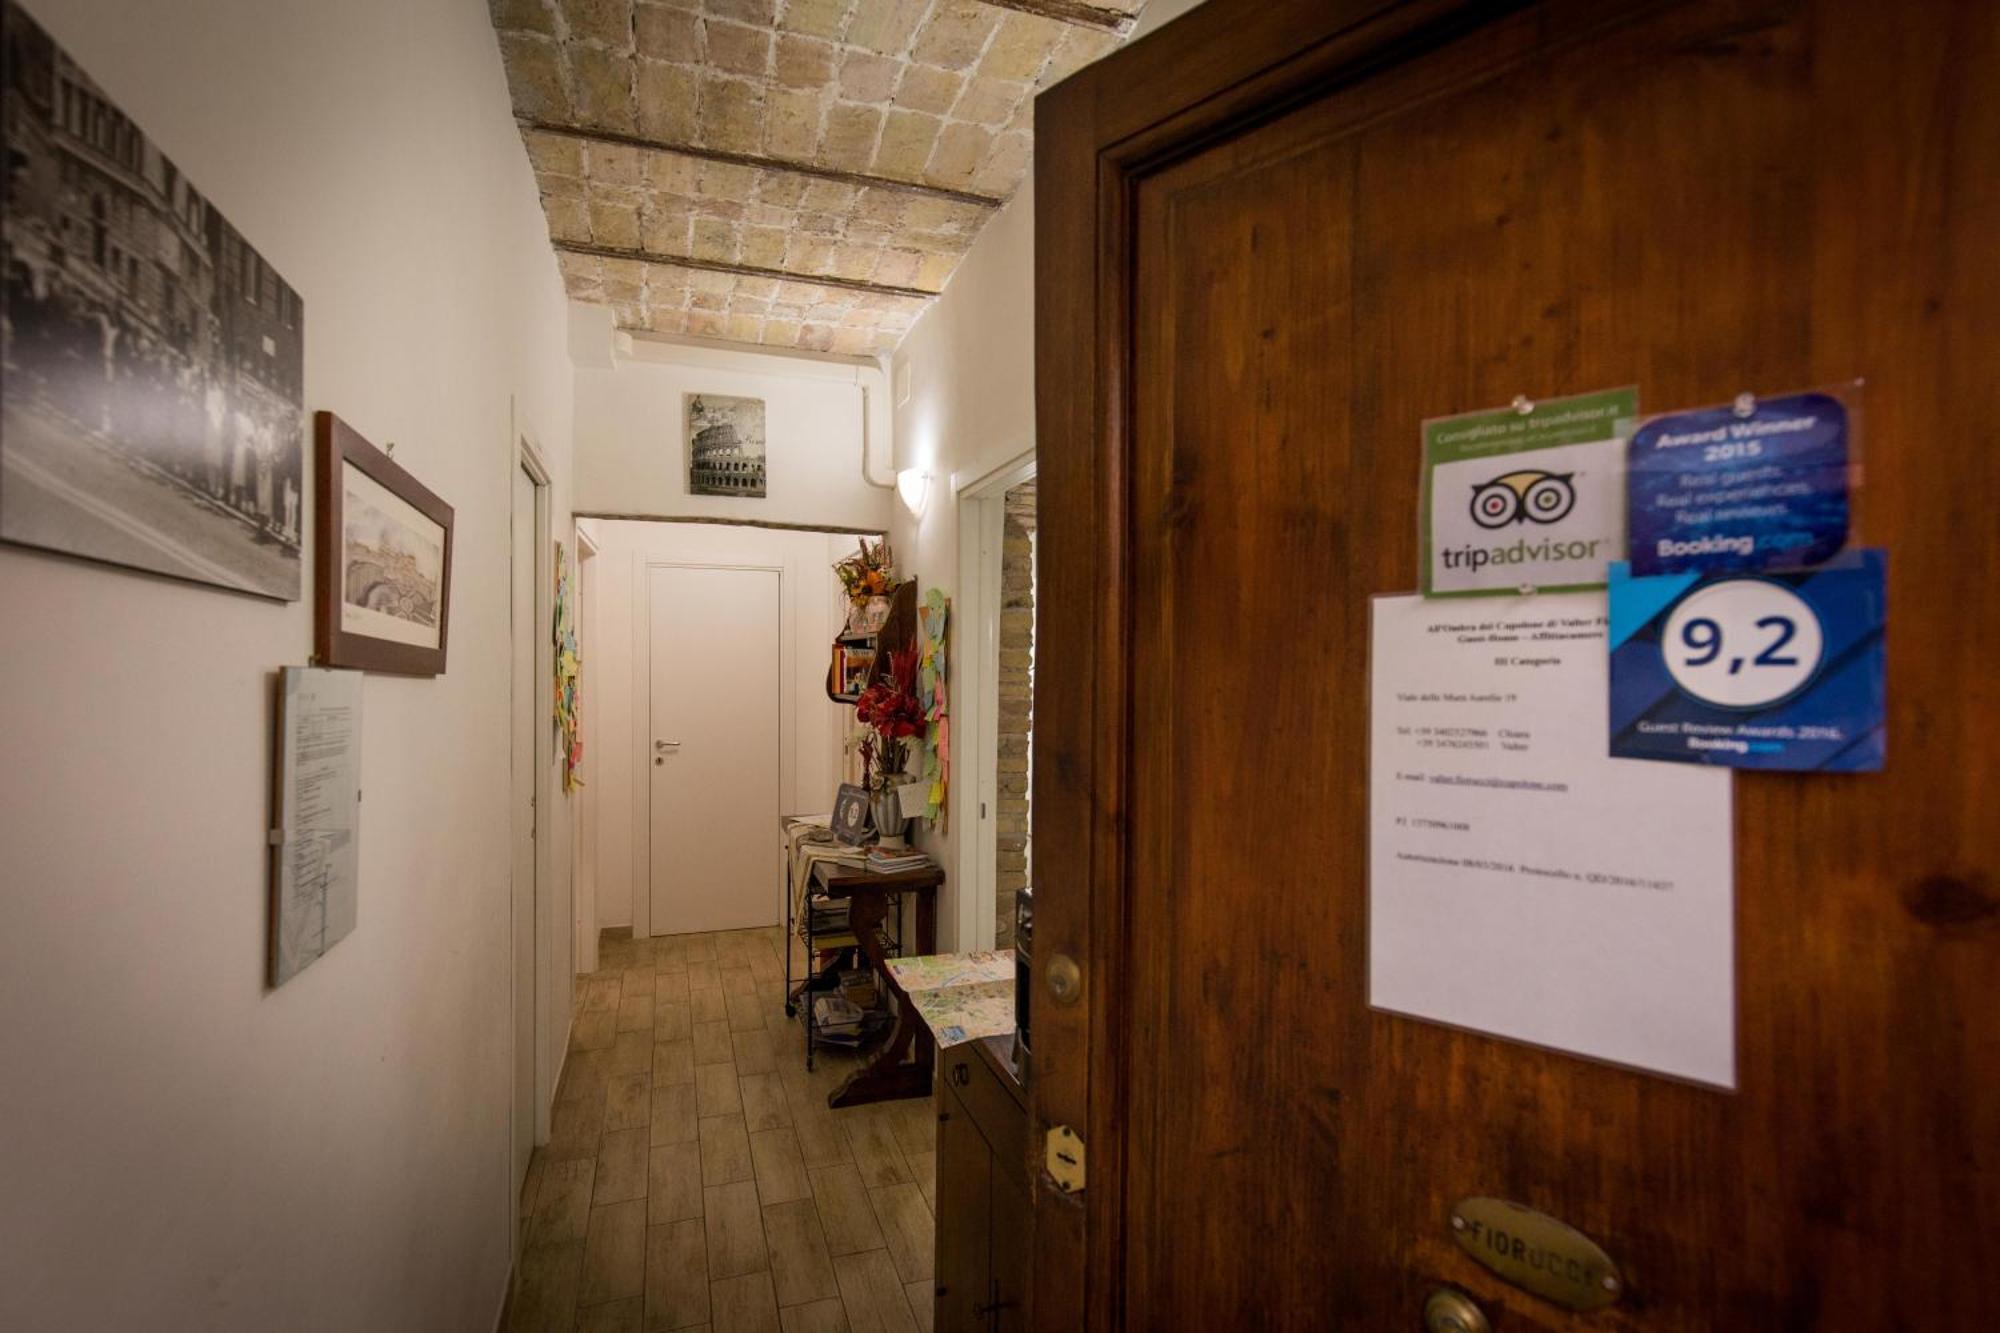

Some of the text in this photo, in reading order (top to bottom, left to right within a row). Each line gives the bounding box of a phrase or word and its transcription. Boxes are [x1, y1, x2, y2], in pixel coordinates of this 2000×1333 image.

[1655, 416, 1818, 448] Award Winner
[1704, 439, 1762, 462] 2015
[1679, 474, 1717, 487] Real
[1656, 494, 1690, 507] Real
[1675, 510, 1713, 525] Real
[1441, 538, 1600, 573] tripadvisor
[1681, 616, 1800, 676] 9,2
[1637, 721, 1679, 734] Guest
[1681, 722, 1734, 736] Review
[1736, 725, 1796, 739] Awards
